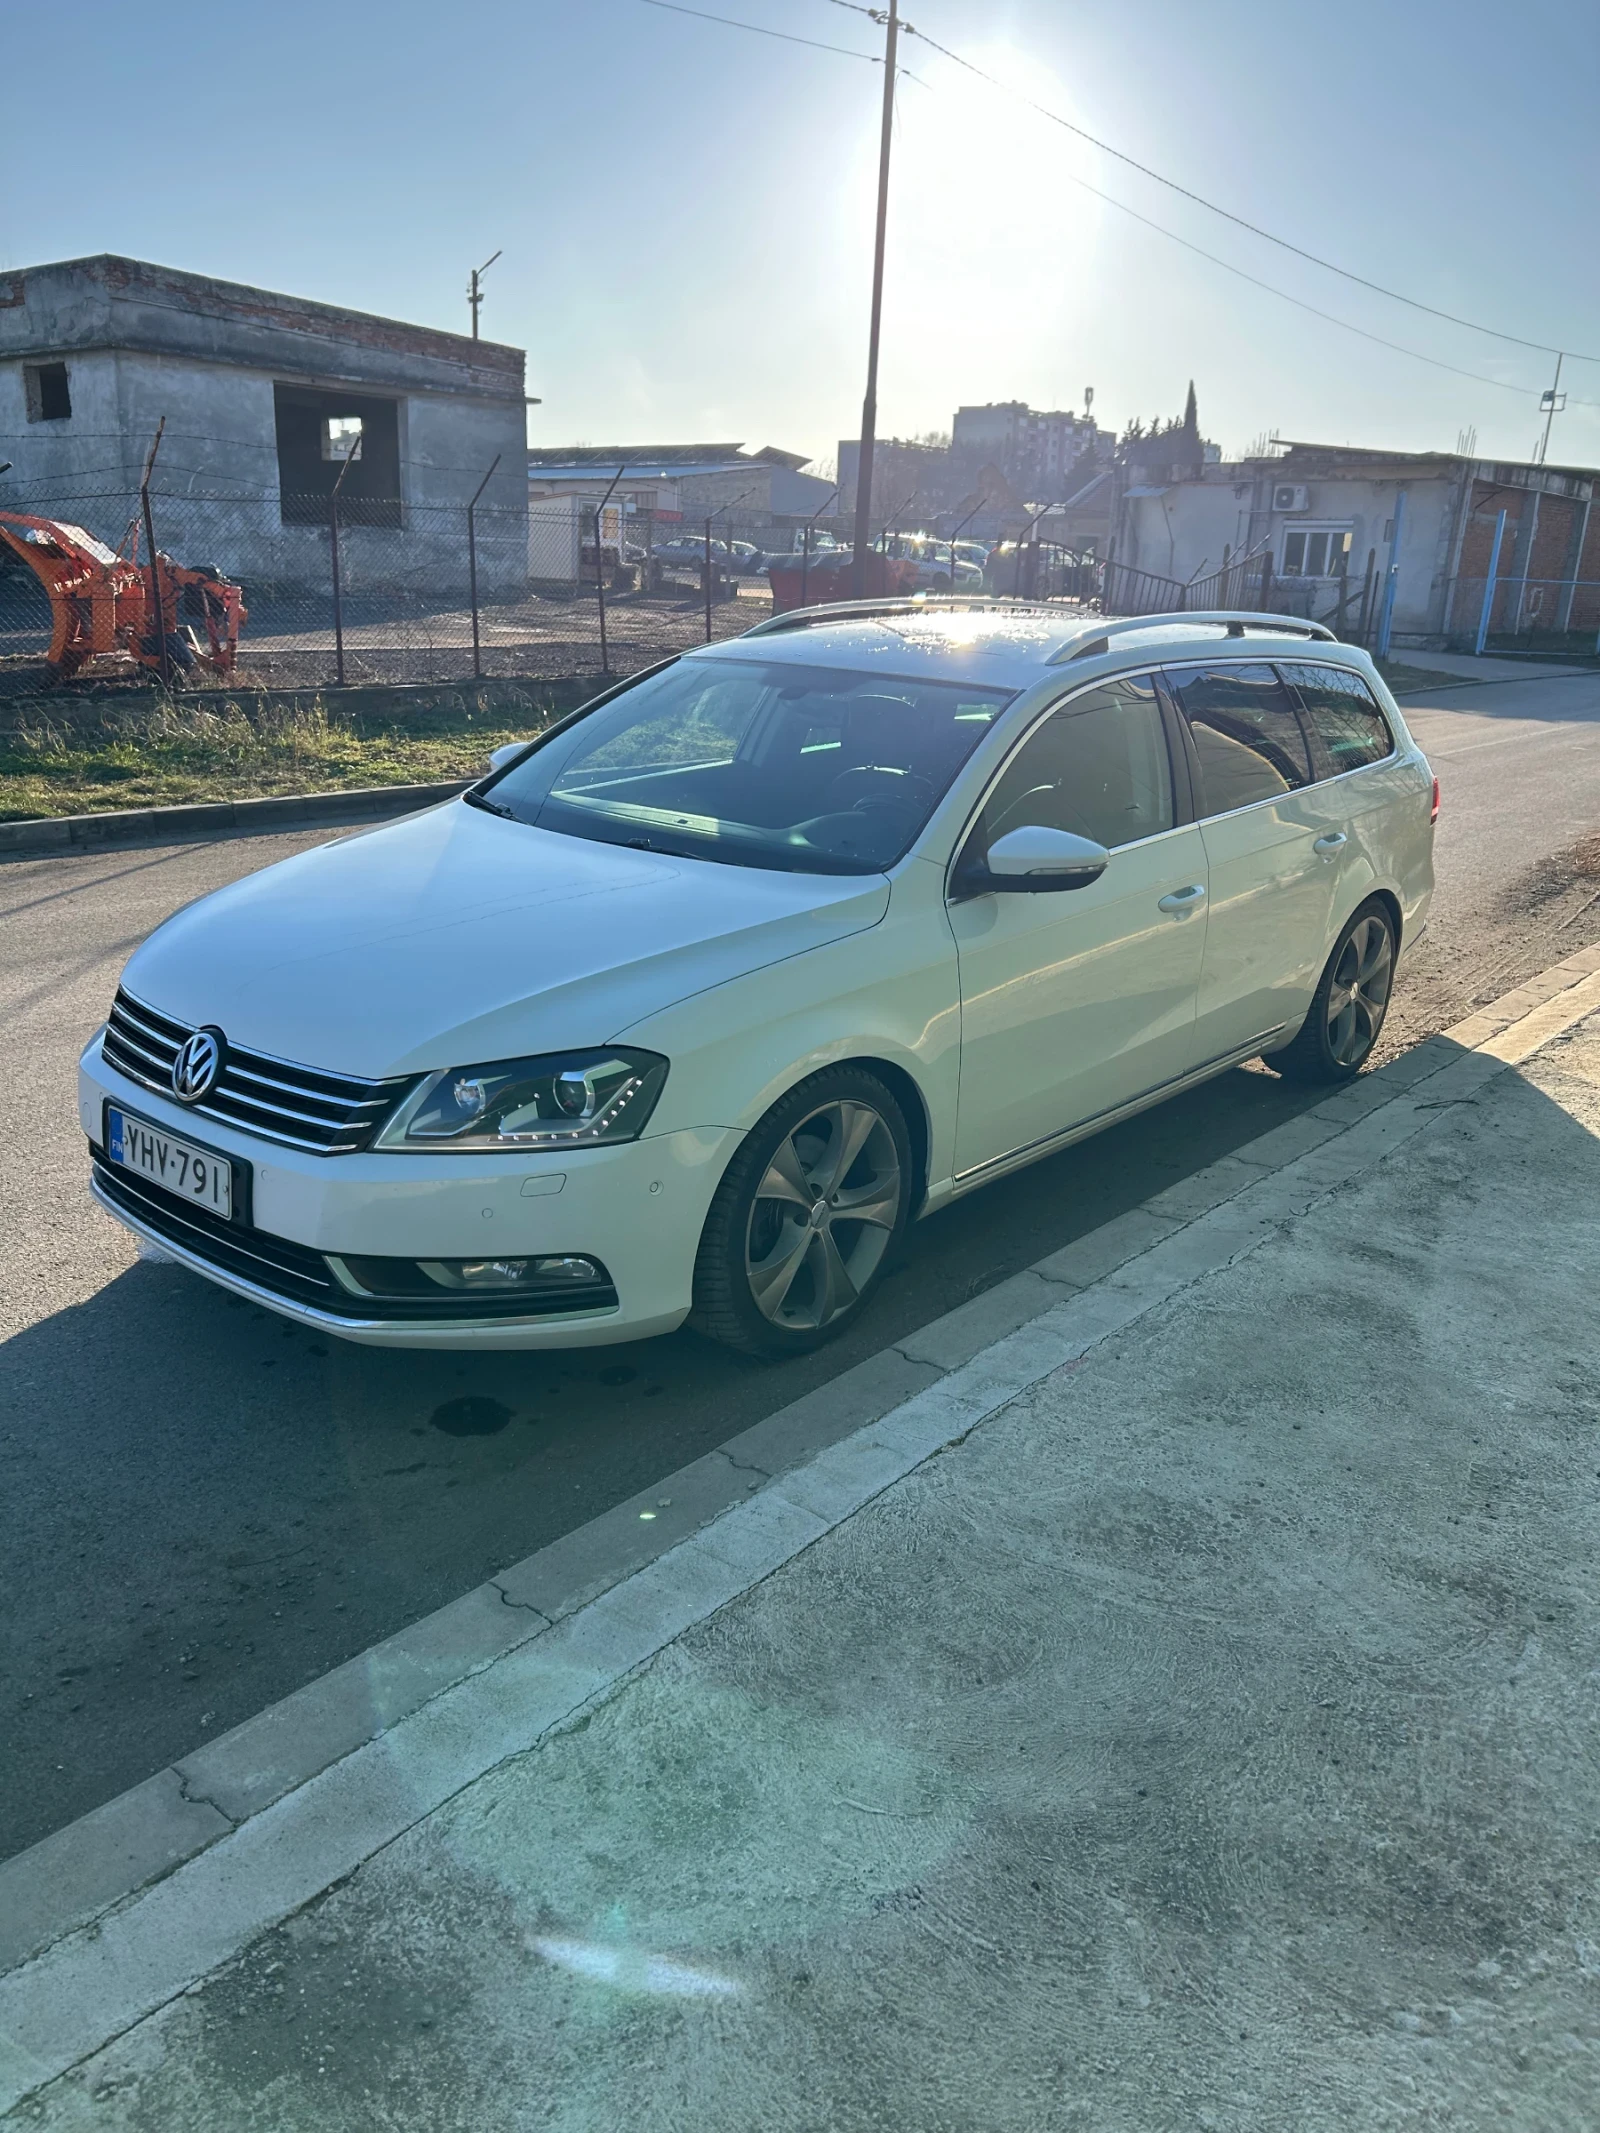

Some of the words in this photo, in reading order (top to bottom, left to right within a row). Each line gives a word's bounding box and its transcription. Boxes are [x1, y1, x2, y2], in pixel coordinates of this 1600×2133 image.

[173, 1033, 219, 1101] VW
[112, 1139, 123, 1153] FIN
[127, 1124, 218, 1203] YHV-791
